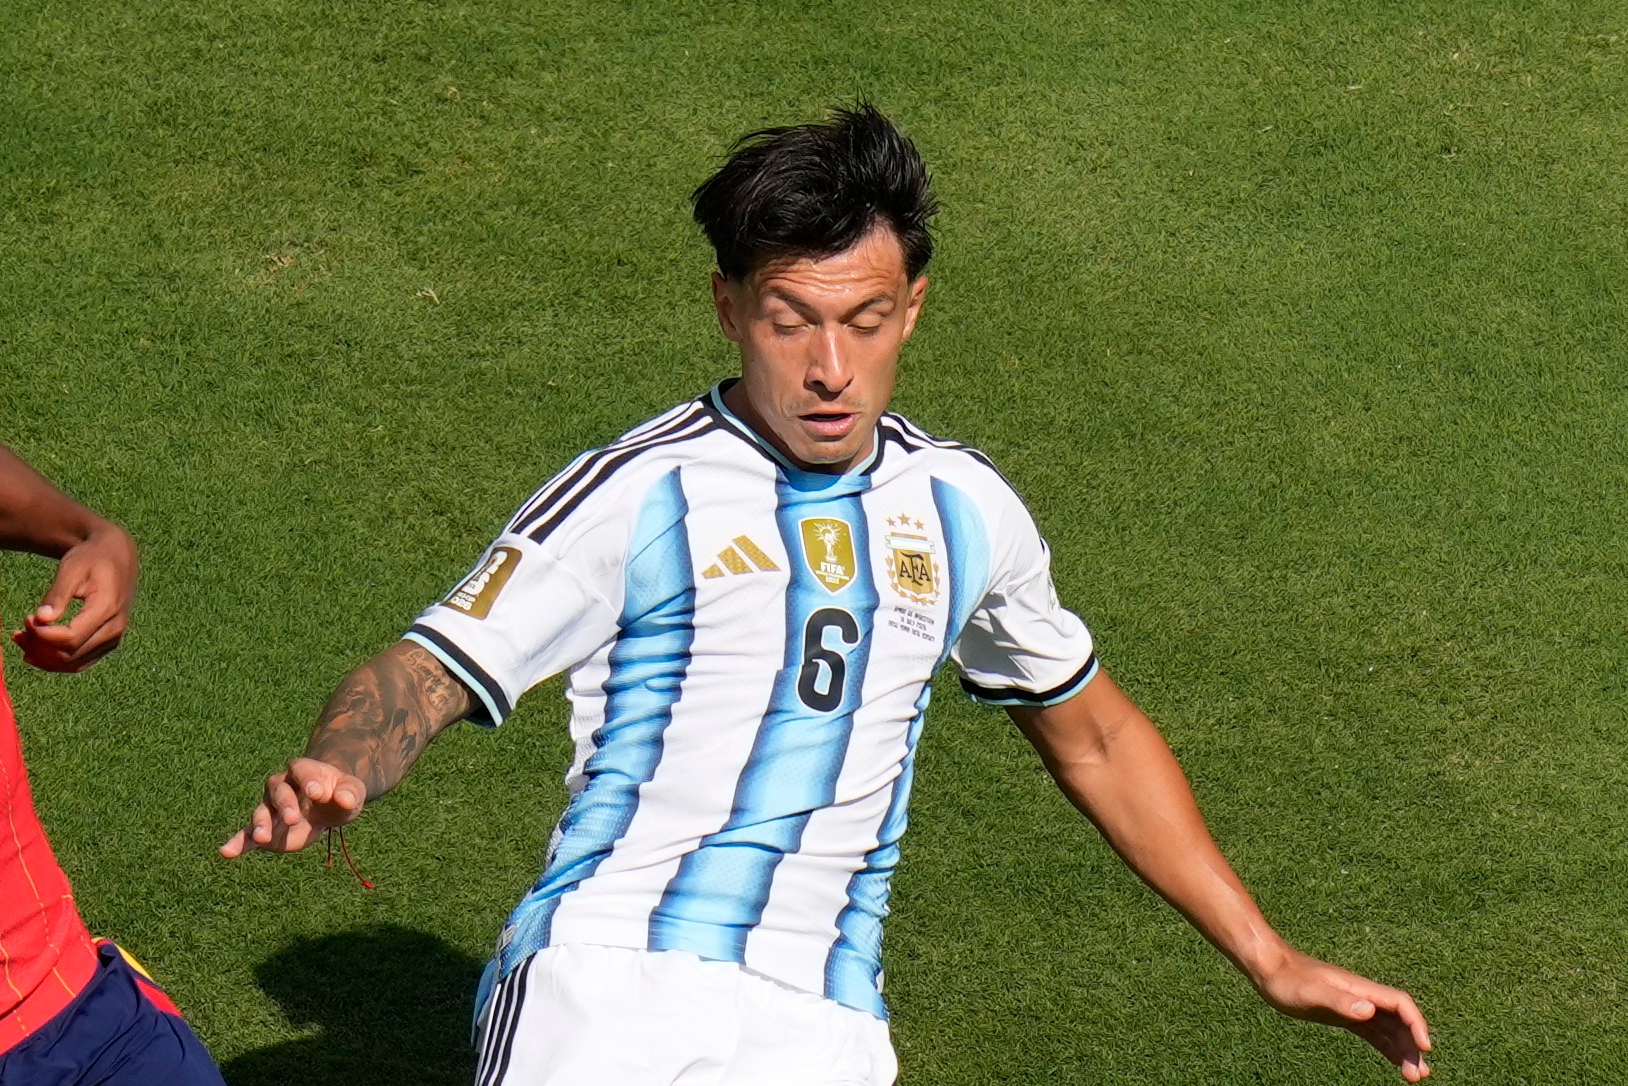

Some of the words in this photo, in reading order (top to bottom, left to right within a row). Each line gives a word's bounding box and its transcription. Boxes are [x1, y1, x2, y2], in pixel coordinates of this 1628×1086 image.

[820, 561, 844, 576] FIFA
[899, 551, 931, 586] AFA
[796, 606, 860, 712] 6
